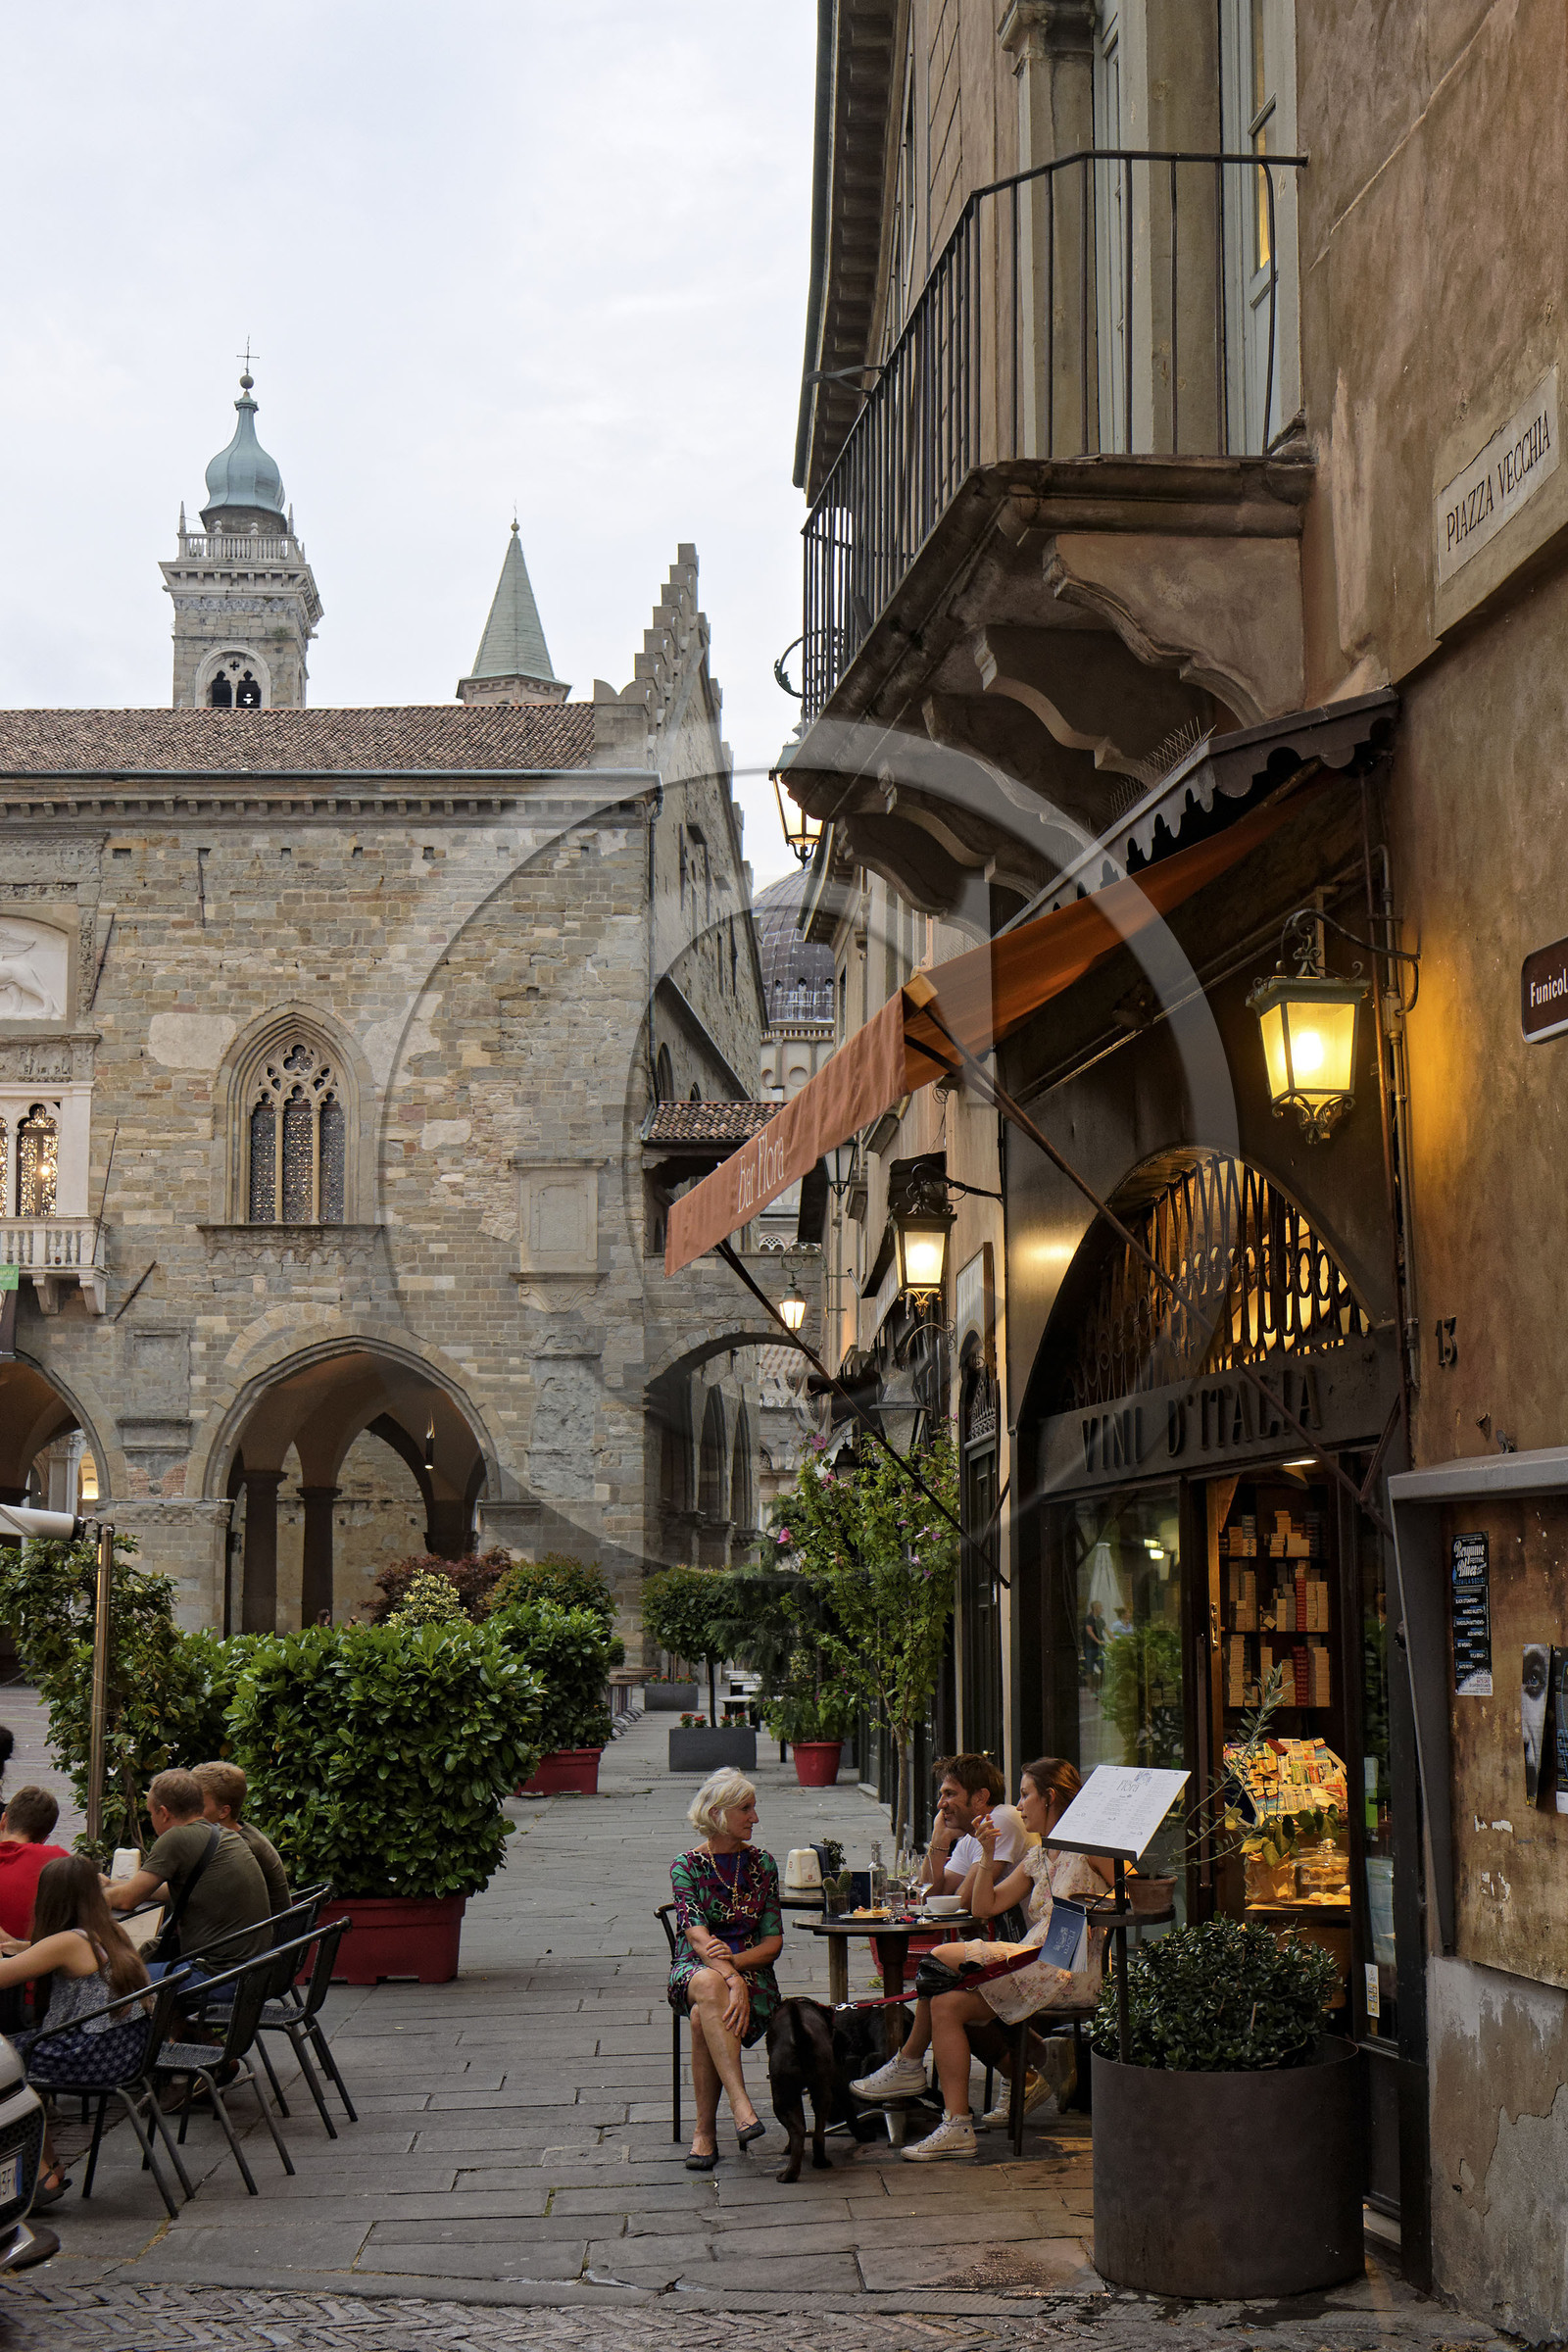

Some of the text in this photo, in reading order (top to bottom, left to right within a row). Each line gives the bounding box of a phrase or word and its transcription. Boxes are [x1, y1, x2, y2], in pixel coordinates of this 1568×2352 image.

[1446, 411, 1550, 552] PIAZZA VECCHIA
[1530, 968, 1568, 1008] Funicol
[758, 1128, 784, 1199] Flora
[1436, 1316, 1458, 1367] 13
[1081, 1364, 1322, 1473] VINI D'ITALIA
